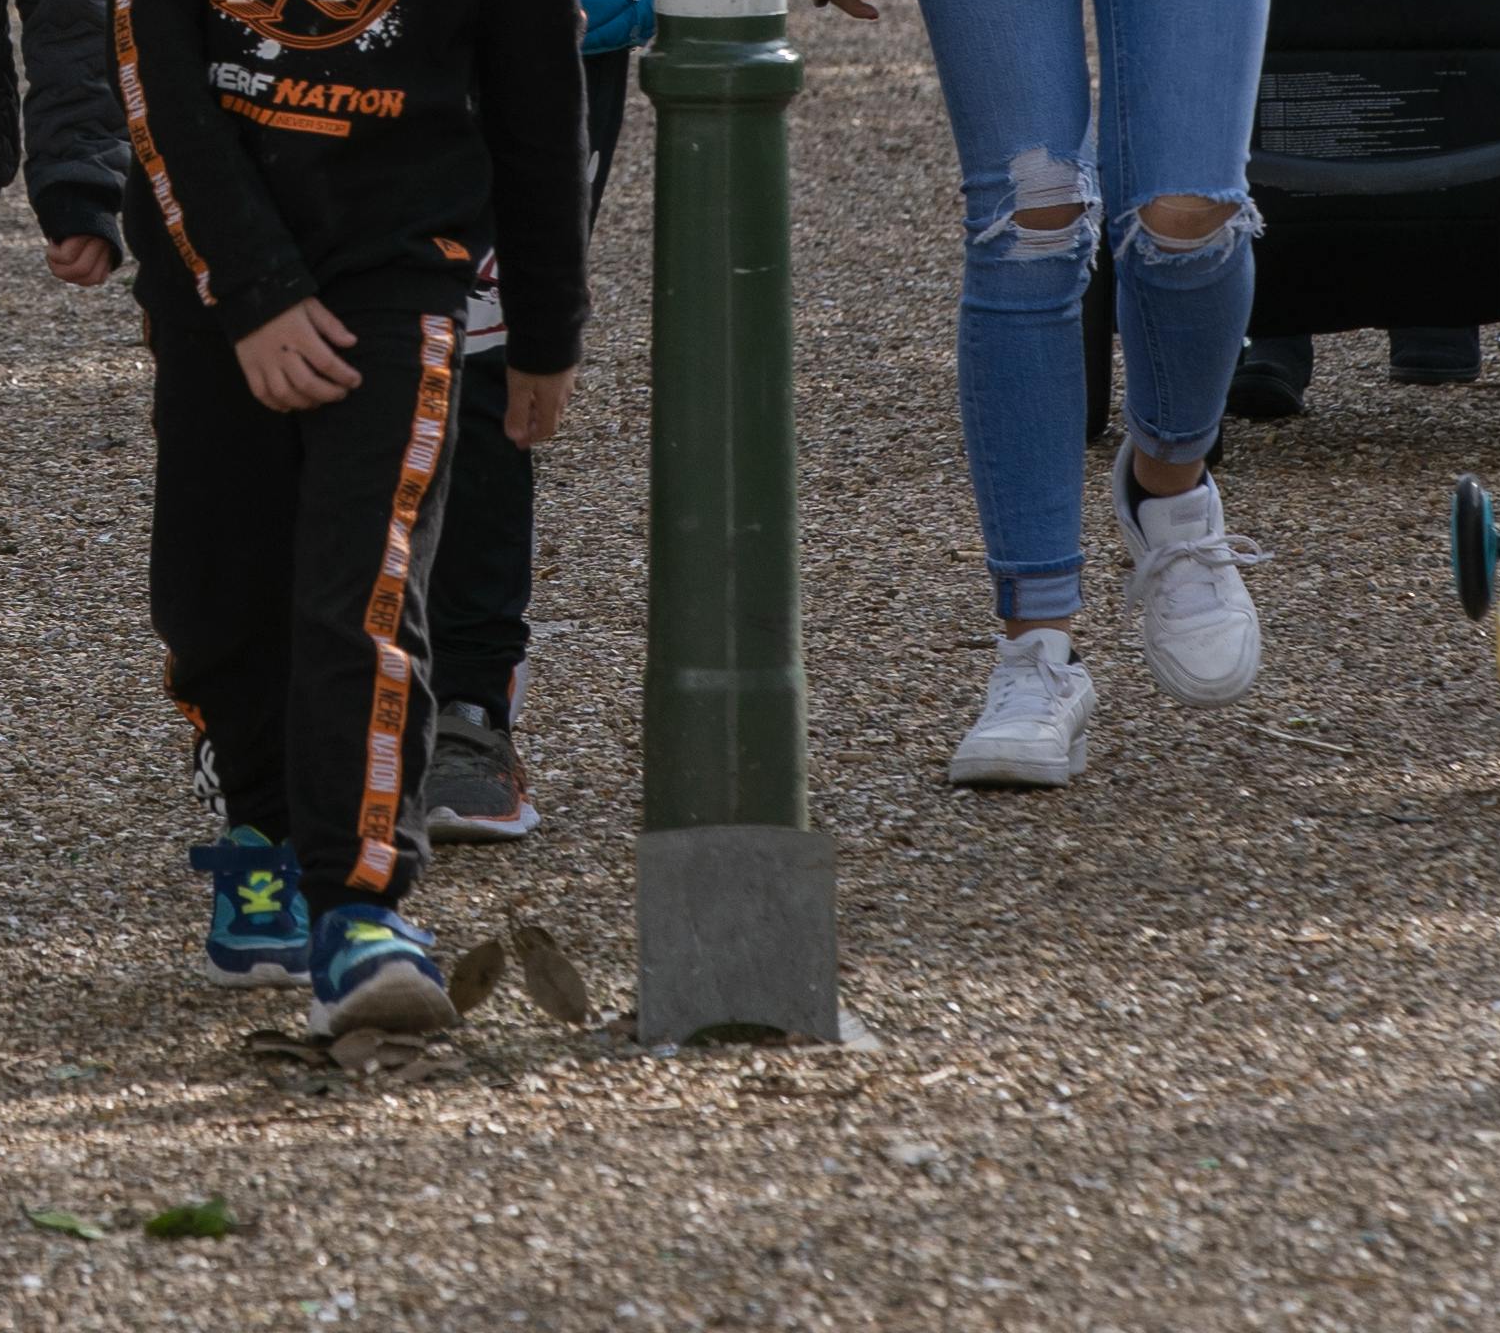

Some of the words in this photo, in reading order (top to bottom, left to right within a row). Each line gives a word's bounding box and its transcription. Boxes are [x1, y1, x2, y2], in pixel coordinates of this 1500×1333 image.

[272, 78, 405, 118] NATION
[276, 116, 315, 130] NEVER
[317, 119, 346, 132] STOP
[406, 416, 442, 473] NATION
[370, 588, 399, 633] NERF
[376, 688, 403, 732] NERF
[369, 732, 398, 793] NATION
